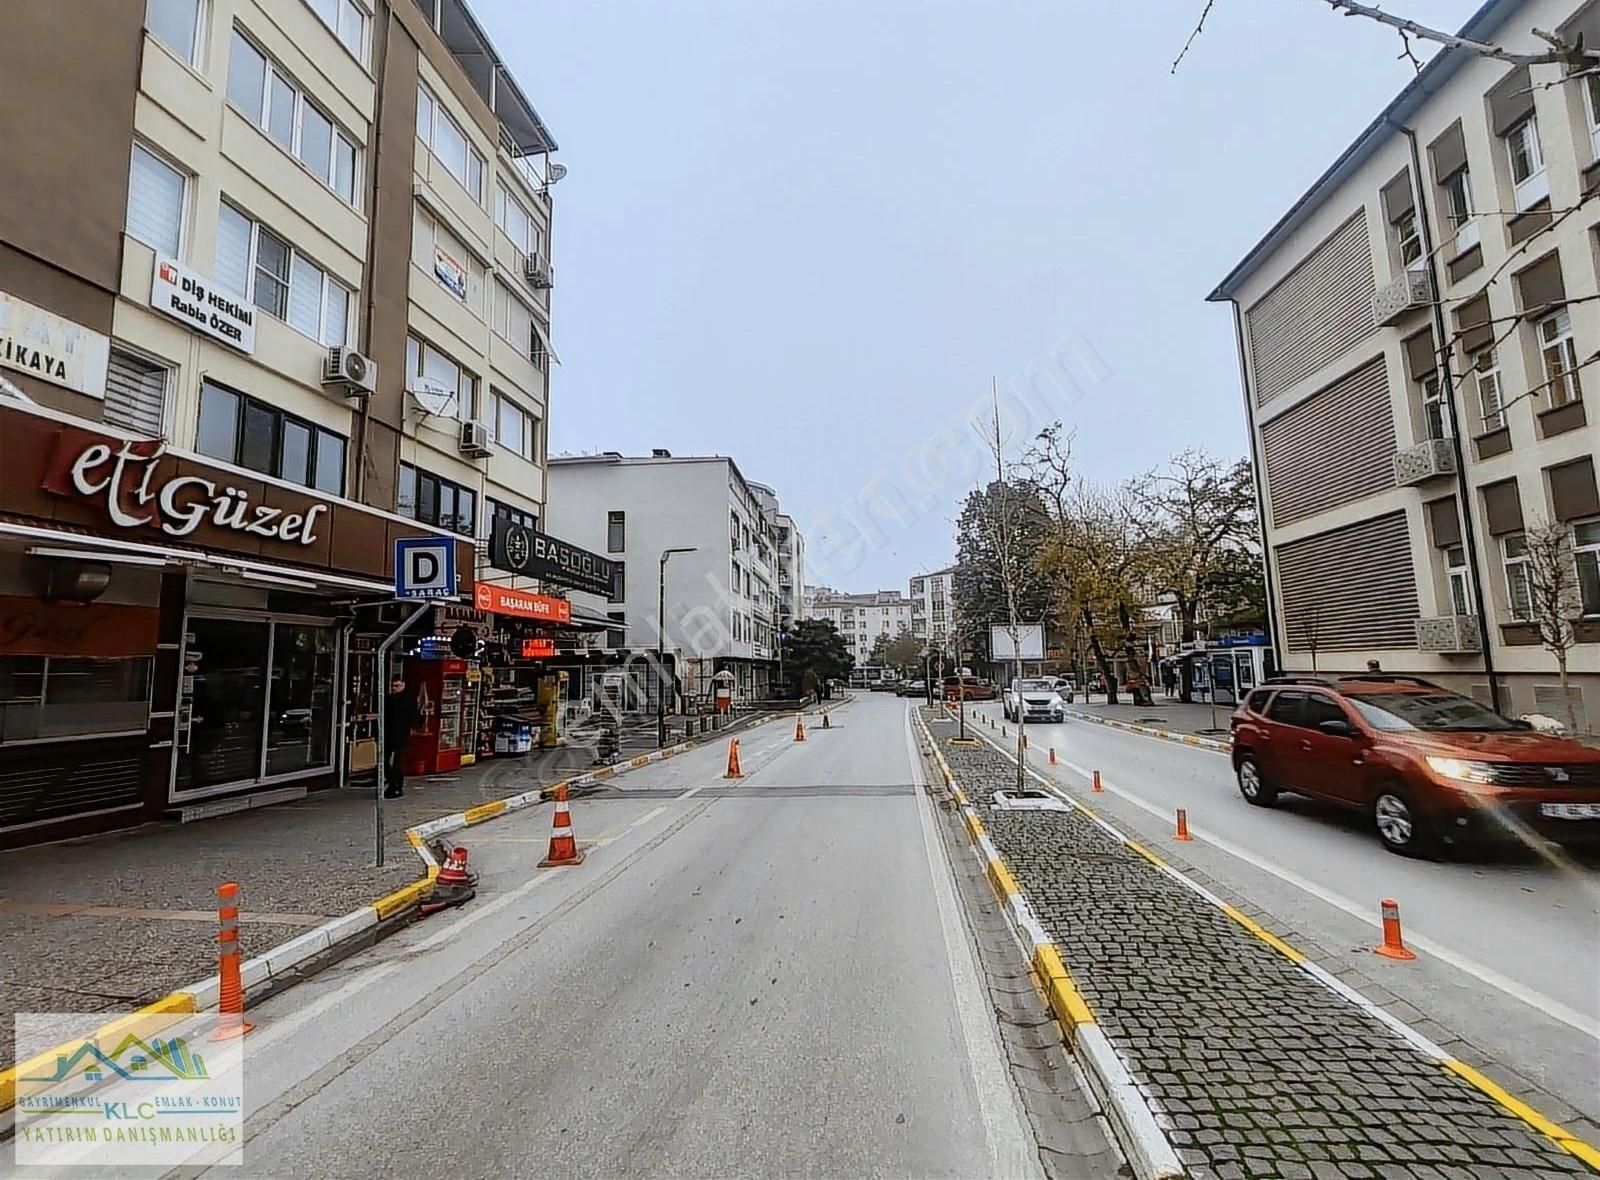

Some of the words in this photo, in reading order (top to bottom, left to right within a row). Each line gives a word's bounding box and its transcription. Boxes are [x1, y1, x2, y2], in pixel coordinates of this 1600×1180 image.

[170, 294, 207, 324] Rabia
[210, 313, 242, 342] ÖZER
[181, 277, 205, 302] DİŞ
[208, 291, 253, 327] HEKİMİ
[0, 337, 66, 380] İKAYA
[160, 477, 328, 545] Güzel
[412, 551, 439, 584] D
